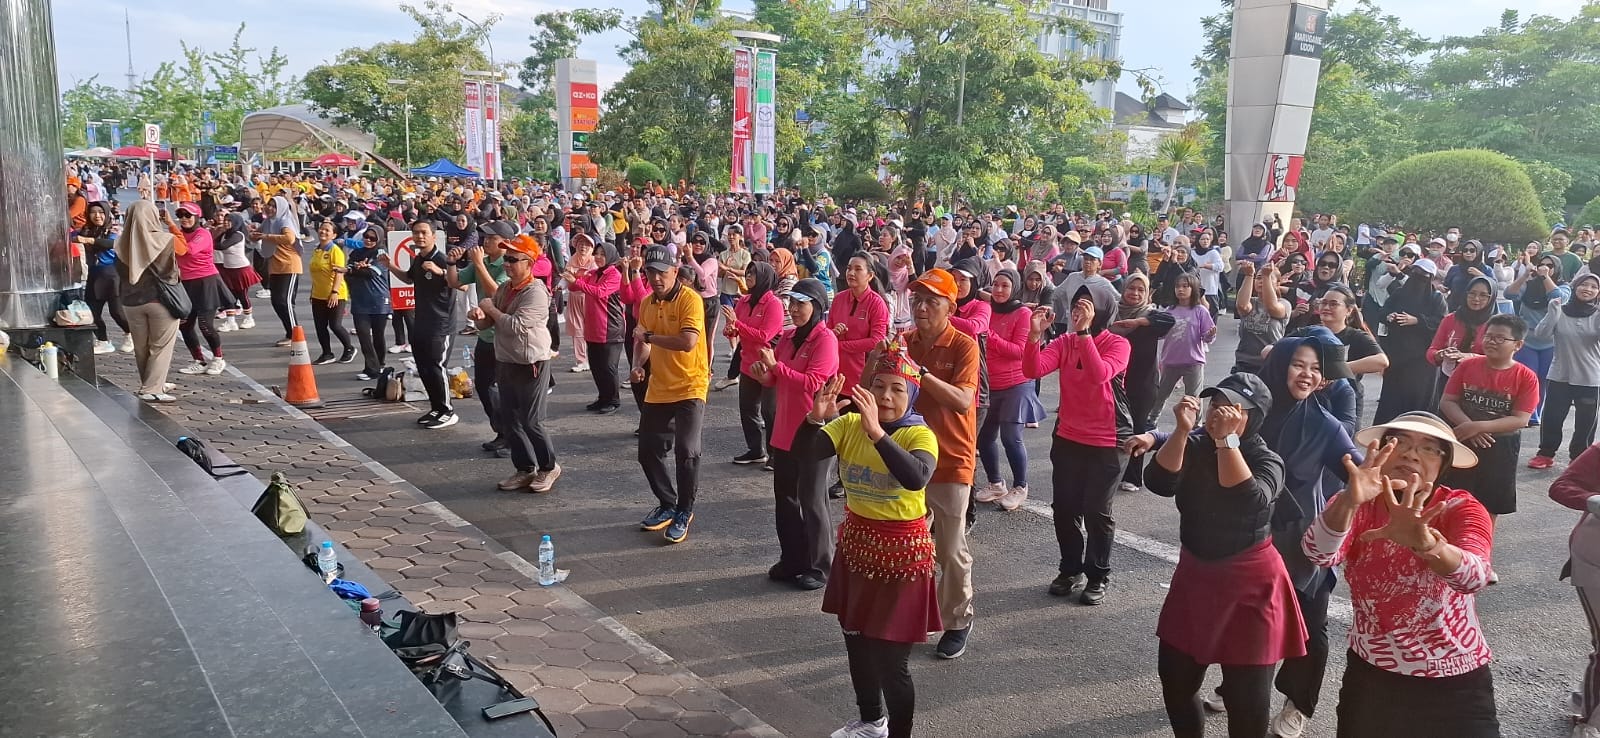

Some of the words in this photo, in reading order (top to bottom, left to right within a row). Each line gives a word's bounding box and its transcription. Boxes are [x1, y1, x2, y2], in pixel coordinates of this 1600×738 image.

[1300, 42, 1315, 53] UDON
[647, 250, 665, 261] RAW
[1464, 392, 1511, 411] CAPTURE
[1428, 651, 1478, 670] FIGHTING
